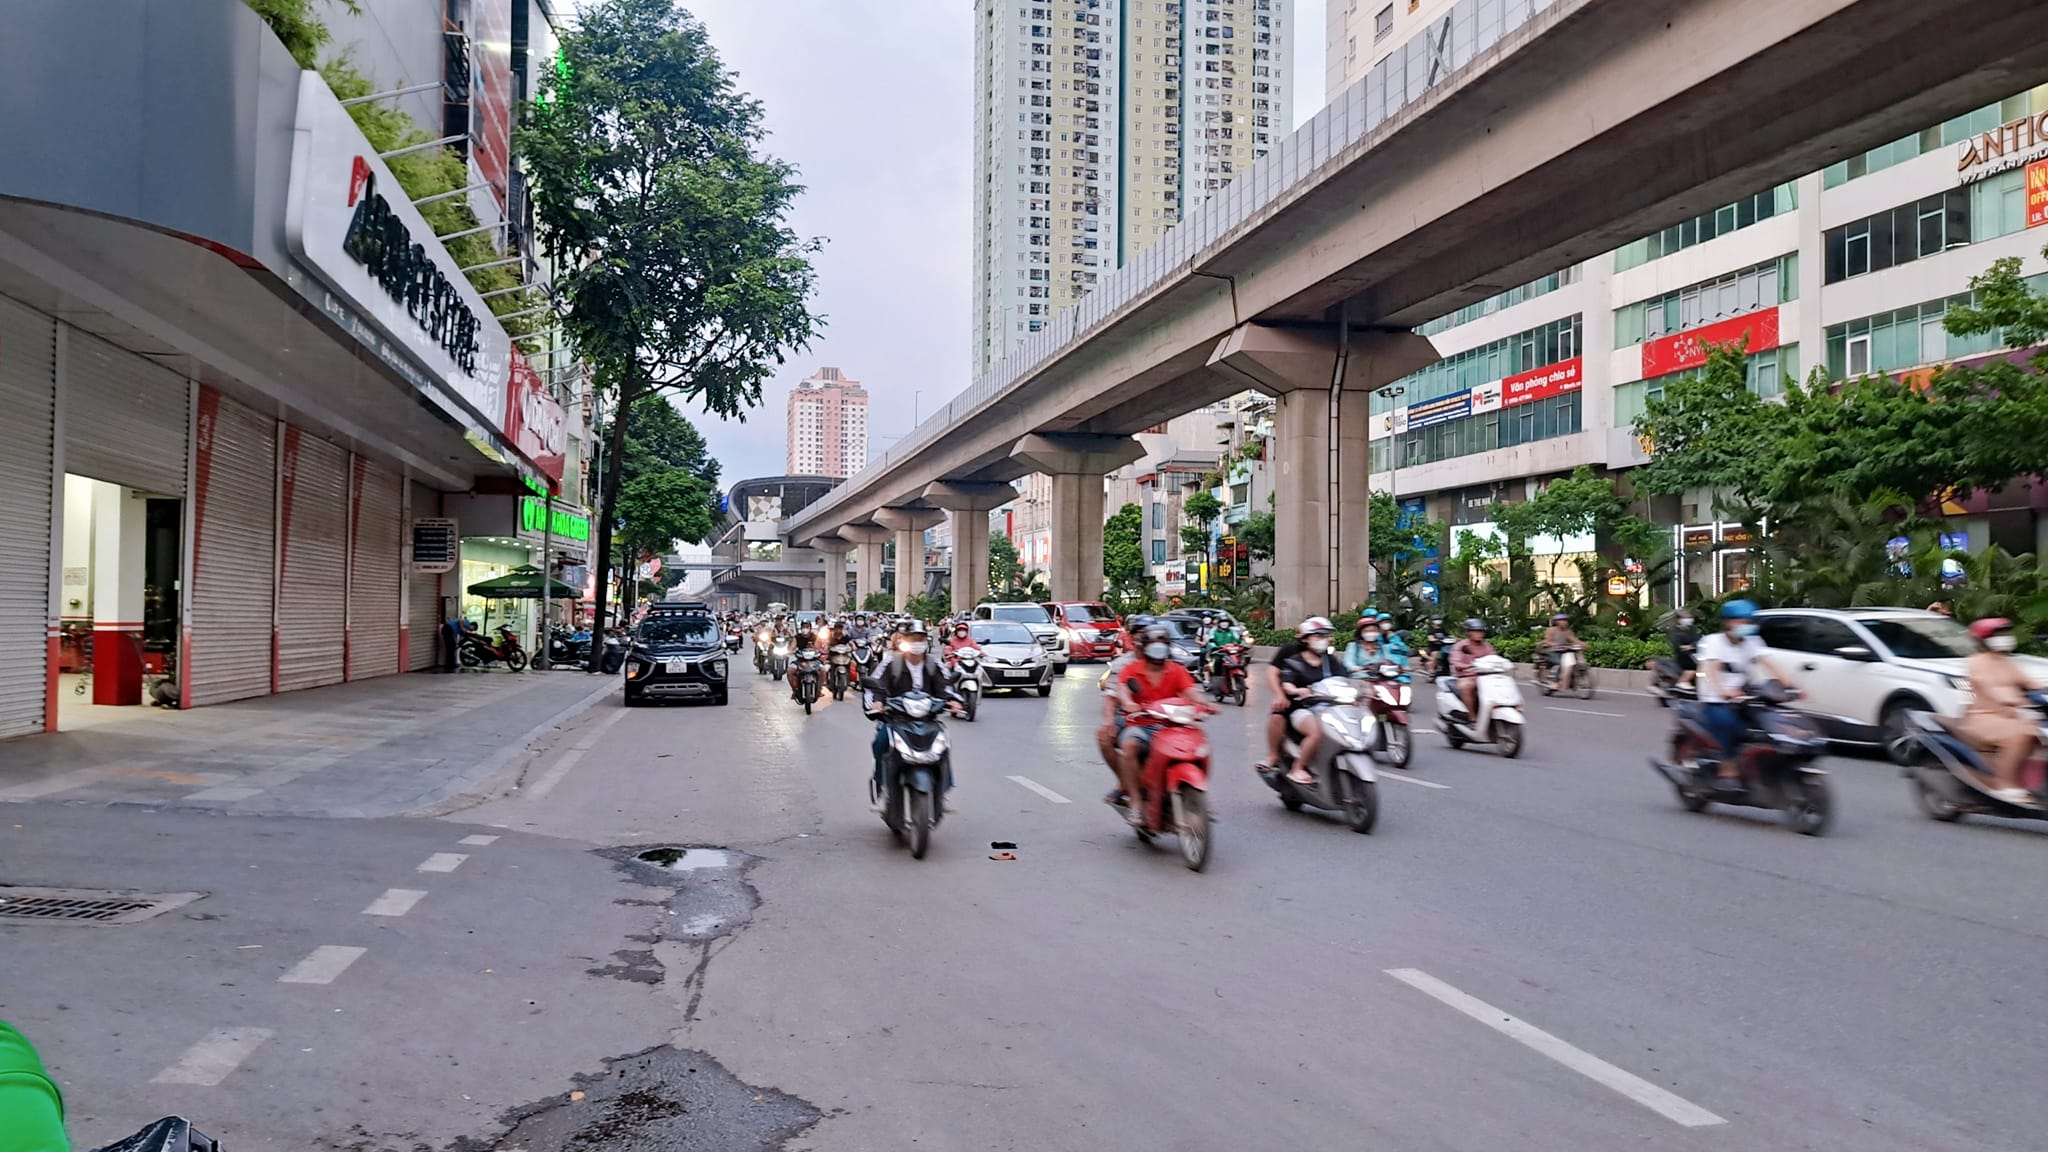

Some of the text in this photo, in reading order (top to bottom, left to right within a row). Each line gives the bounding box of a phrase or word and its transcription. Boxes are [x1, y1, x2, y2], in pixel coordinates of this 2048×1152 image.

[1510, 382, 1524, 393] Văn
[1525, 375, 1548, 391] phòng
[1549, 370, 1566, 382] chia
[570, 516, 589, 542] GREEN
